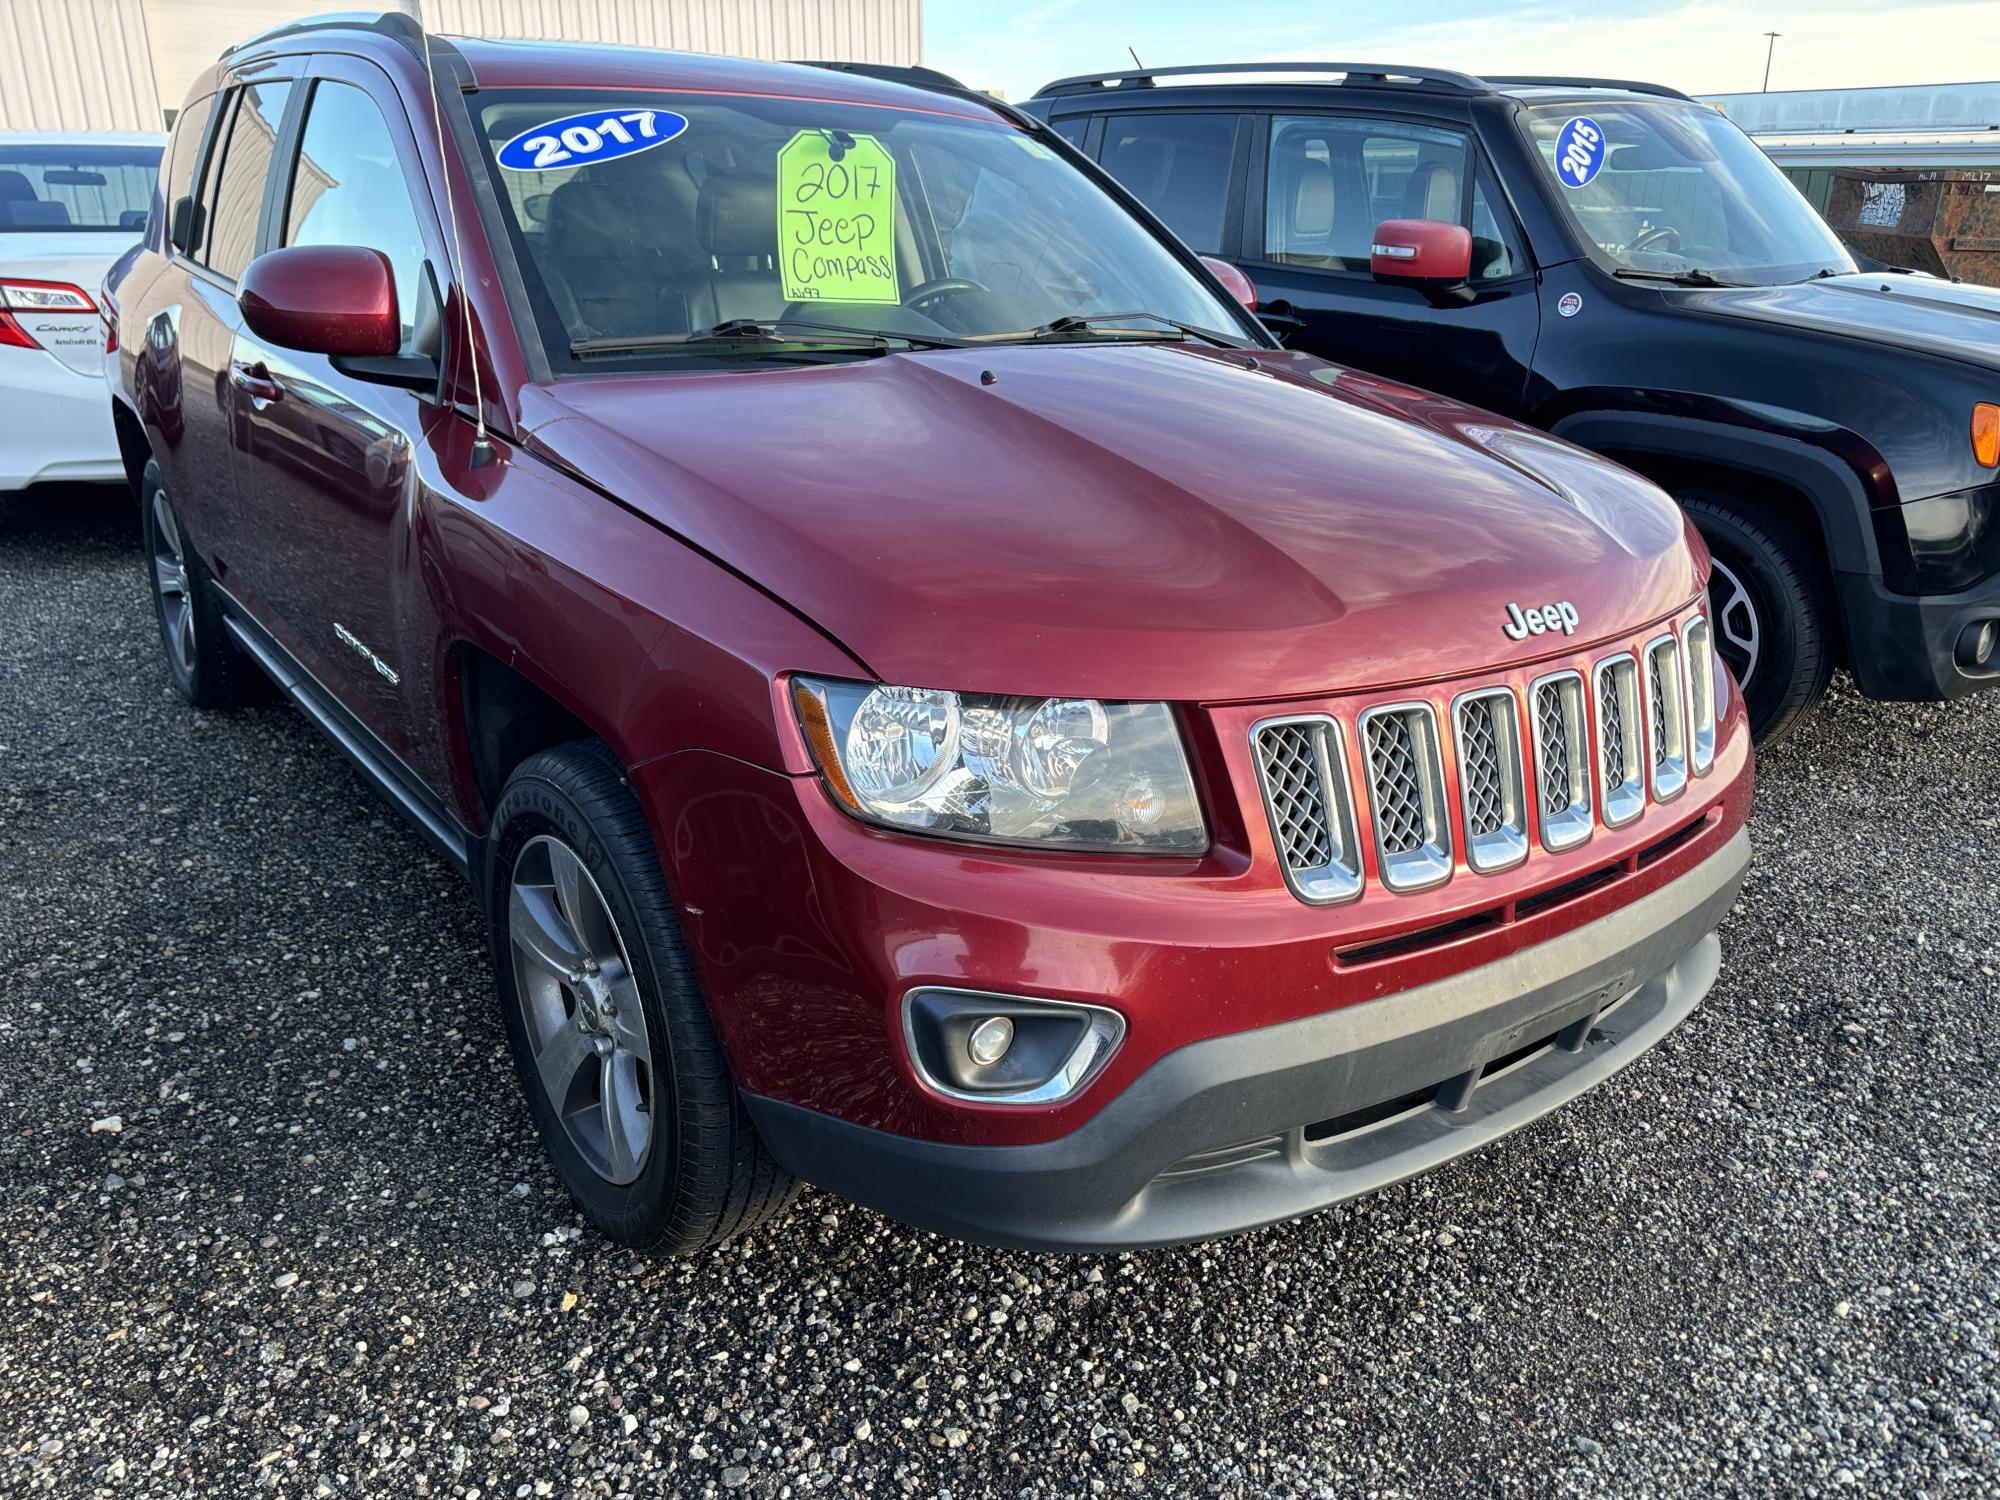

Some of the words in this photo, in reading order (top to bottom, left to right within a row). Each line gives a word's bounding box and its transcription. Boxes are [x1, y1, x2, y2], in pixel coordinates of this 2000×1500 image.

[523, 111, 657, 168] 2017
[1562, 120, 1599, 183] 2015
[796, 162, 881, 203] 2017
[786, 210, 875, 251] Jeep
[792, 247, 892, 283] Compass
[1502, 601, 1579, 640] Jeep
